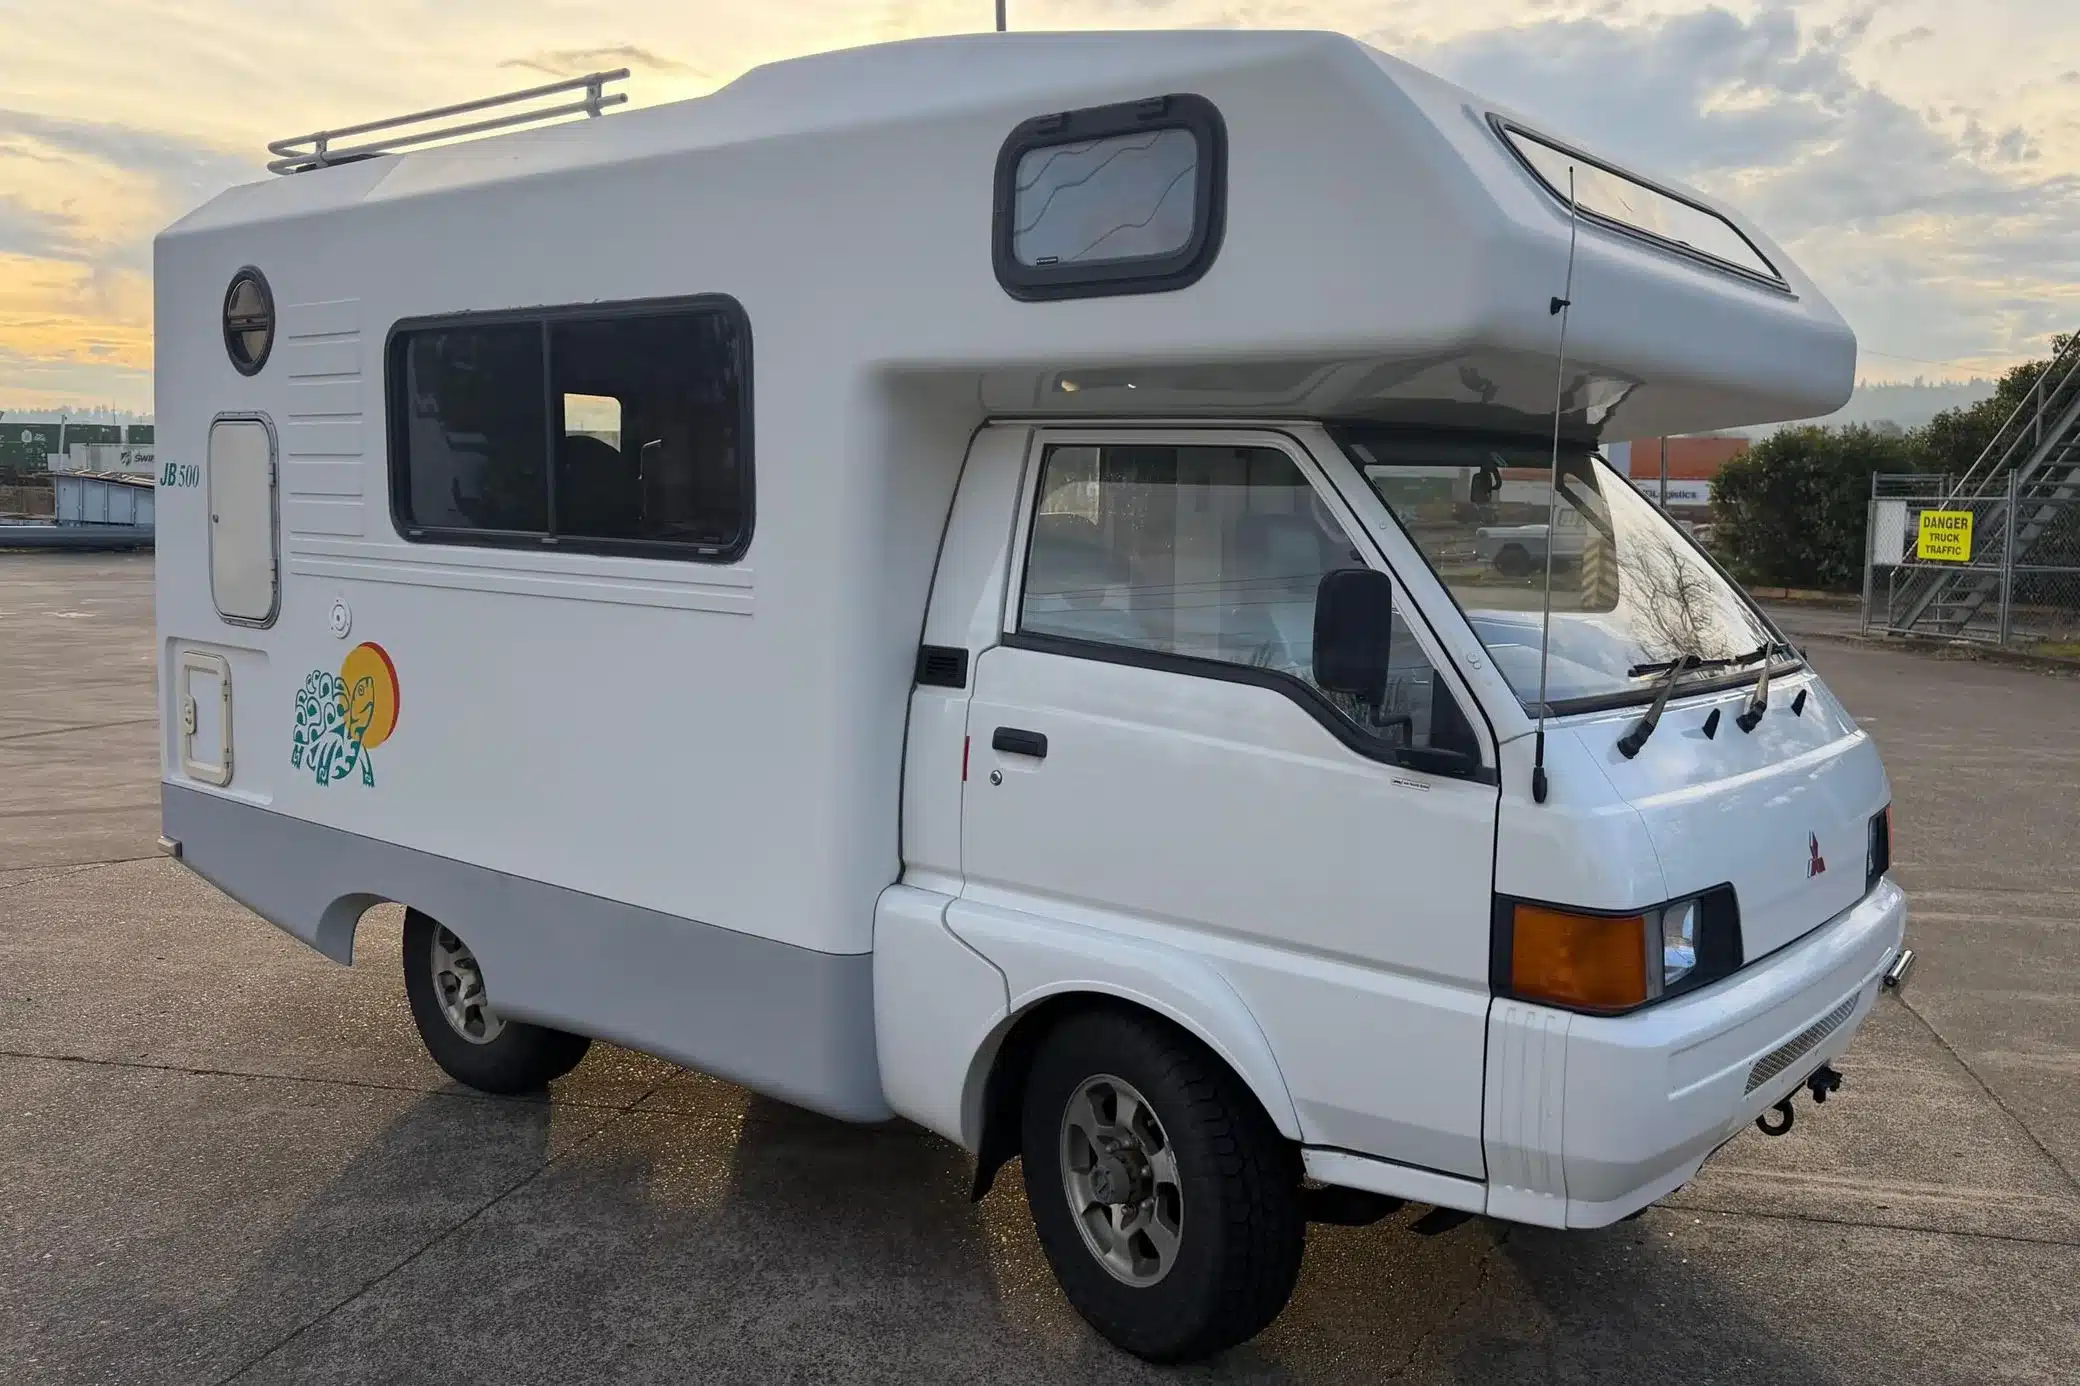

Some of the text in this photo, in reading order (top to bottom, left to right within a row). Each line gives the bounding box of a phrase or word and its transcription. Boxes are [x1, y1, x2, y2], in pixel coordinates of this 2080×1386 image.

[160, 462, 199, 488] JB 500
[1924, 516, 1968, 529] DANGER
[1929, 532, 1960, 543] TRUCK
[1925, 545, 1961, 555] TRAFFIC
